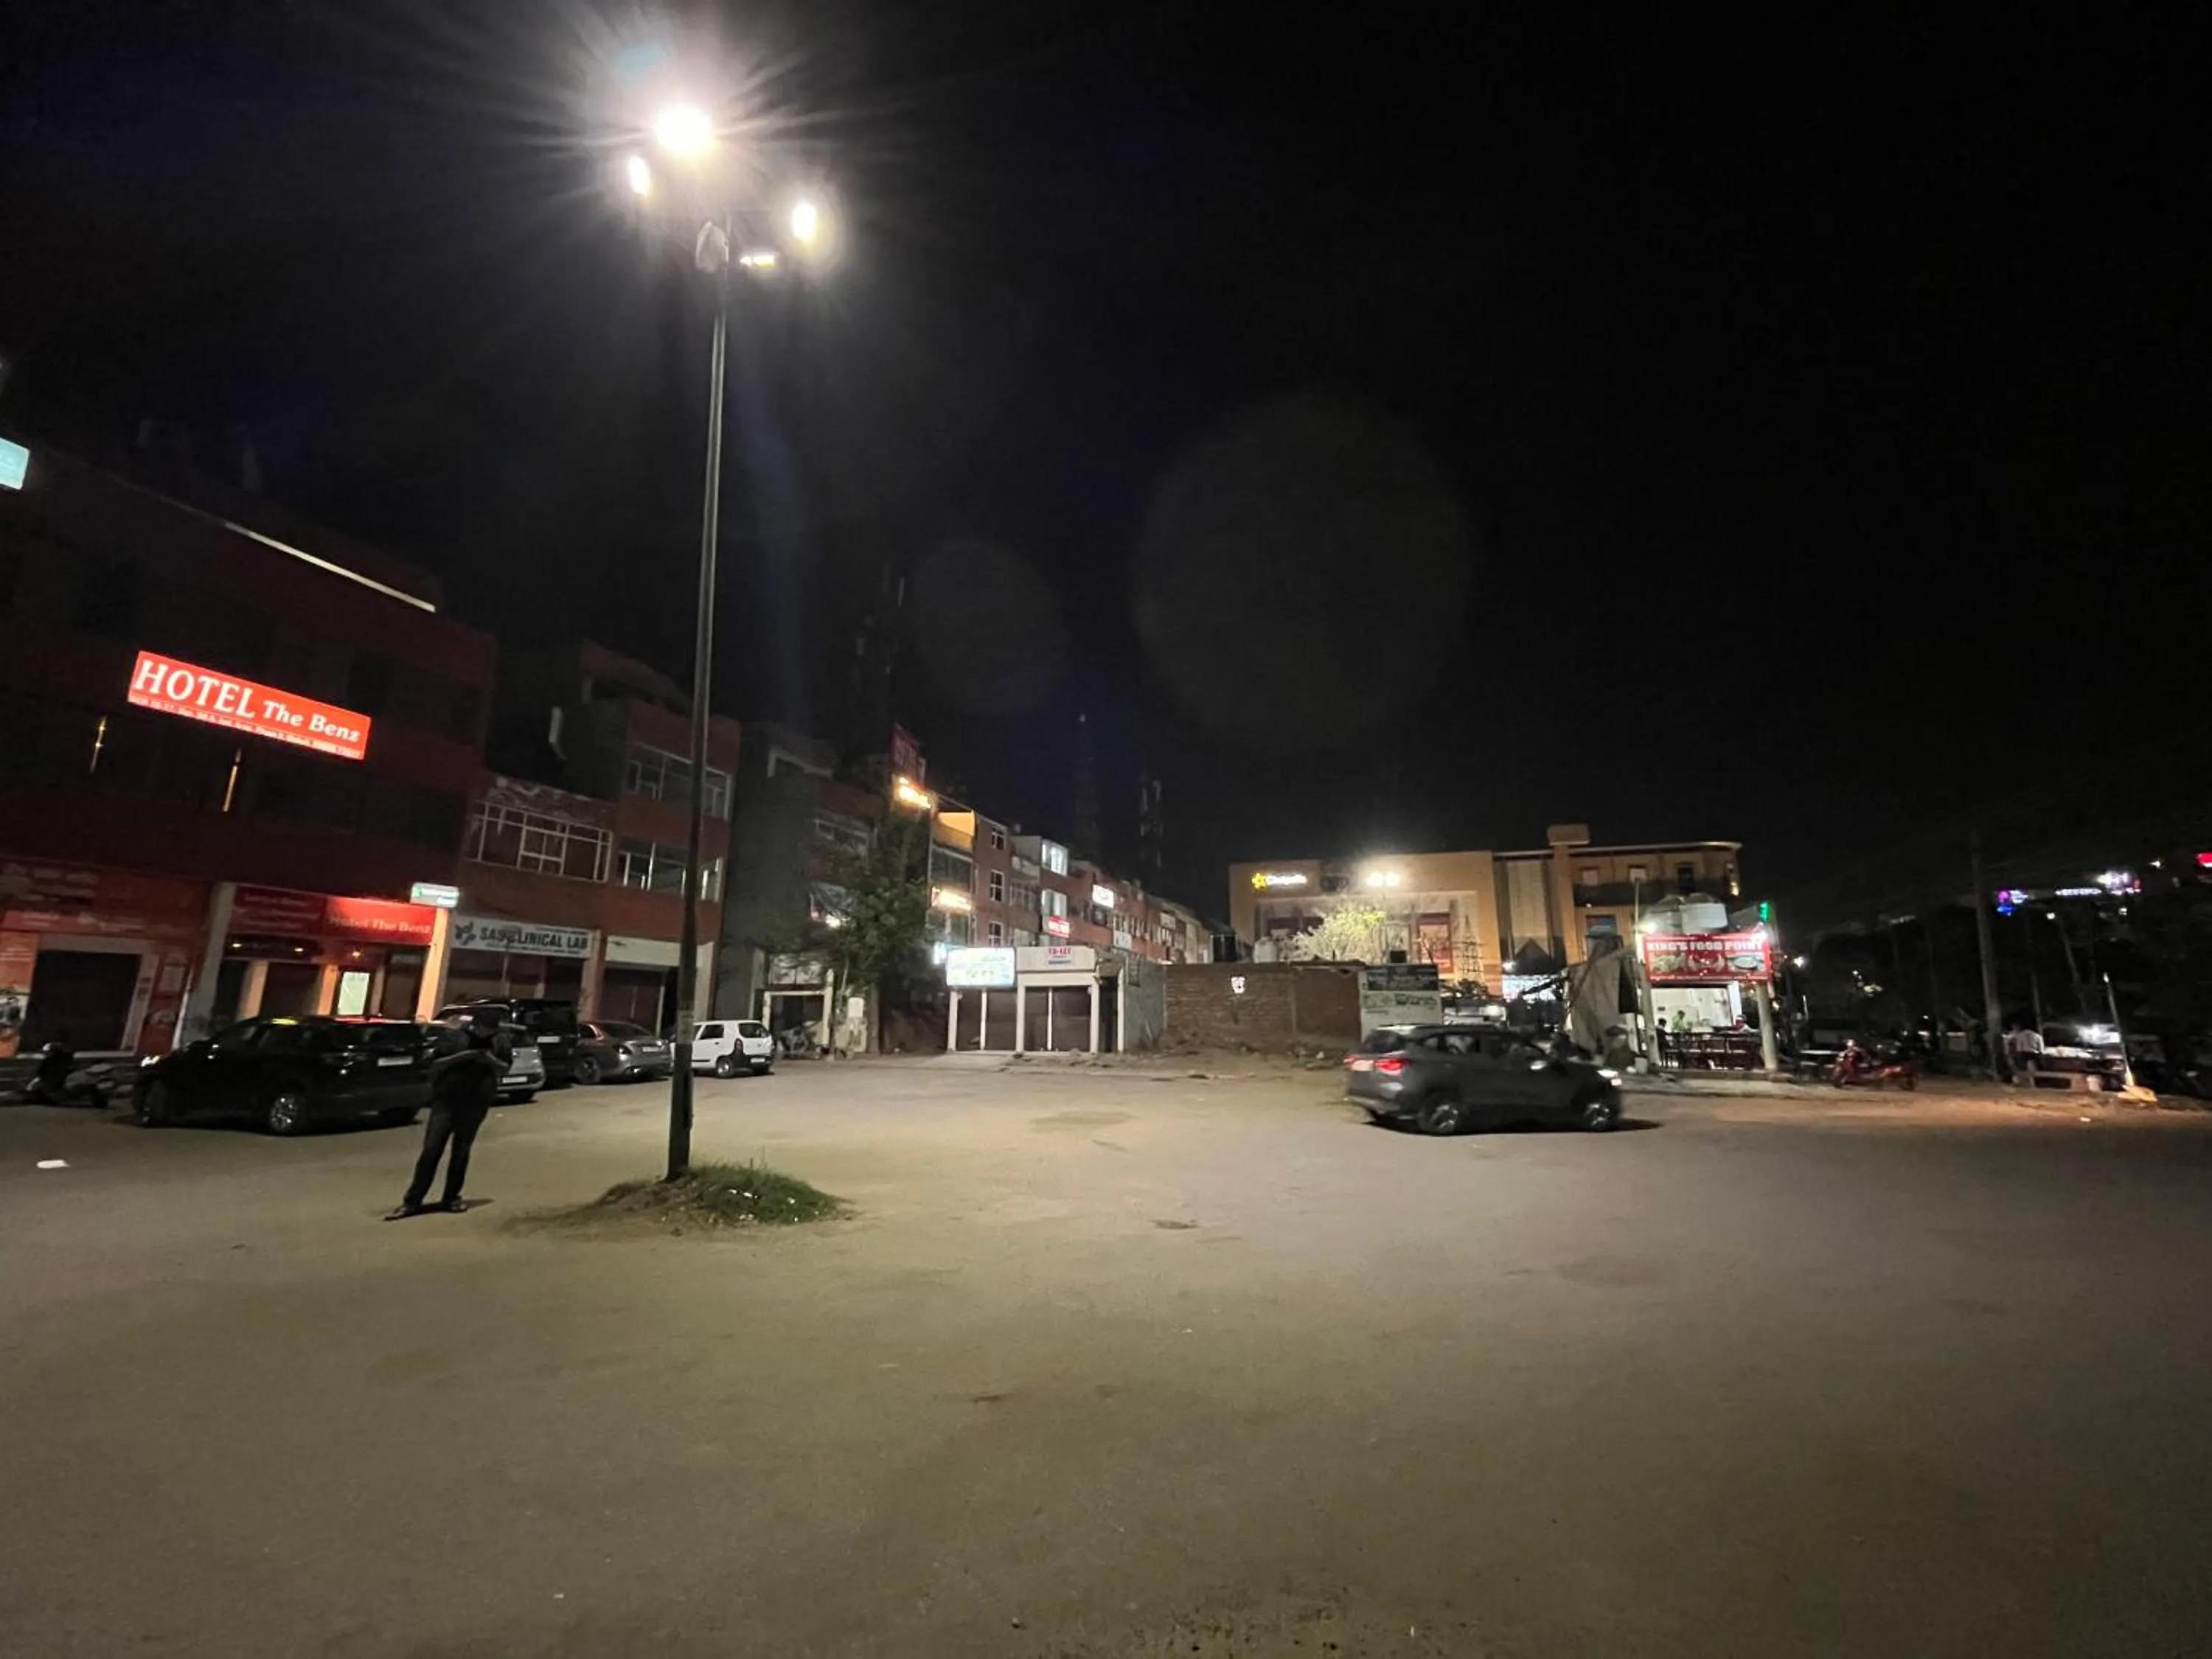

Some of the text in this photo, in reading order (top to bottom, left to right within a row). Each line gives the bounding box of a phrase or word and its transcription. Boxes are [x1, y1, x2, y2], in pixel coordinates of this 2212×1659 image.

[133, 659, 256, 719] HOTEL
[262, 700, 304, 727] The
[308, 713, 361, 743] Benz
[329, 917, 431, 934] Hotel The Benz
[566, 936, 588, 950] LAB
[1689, 941, 1723, 951] FOOD
